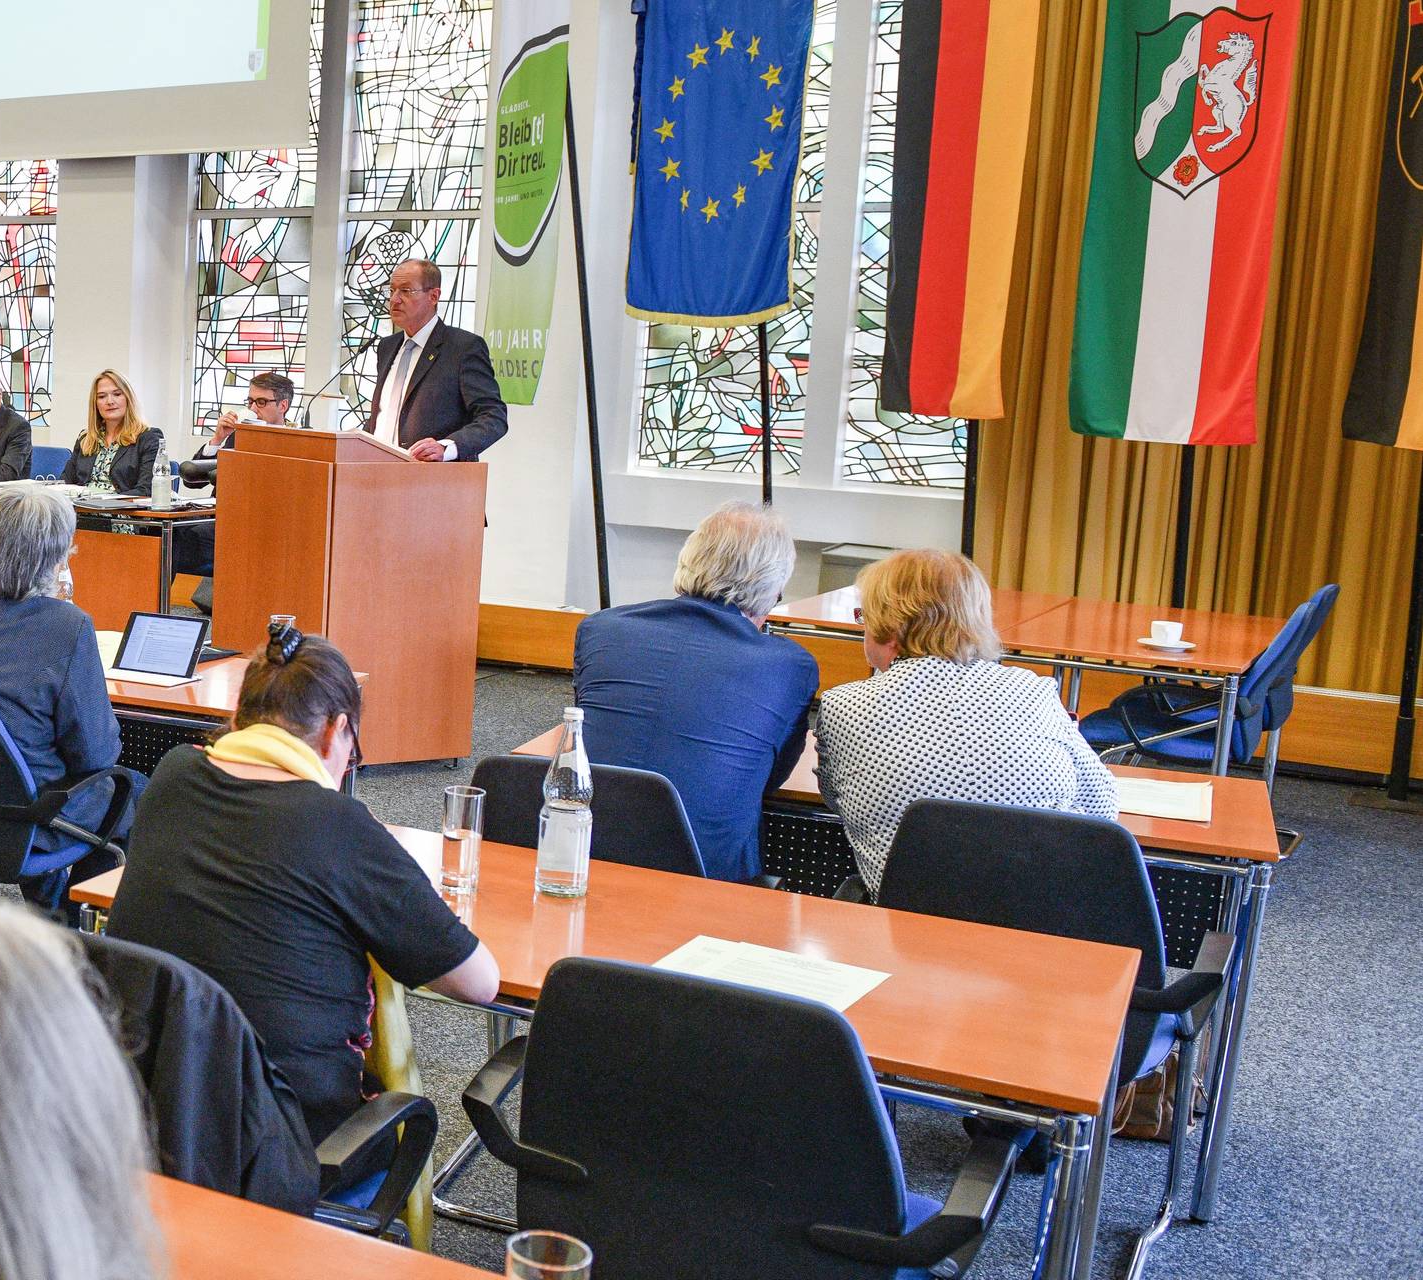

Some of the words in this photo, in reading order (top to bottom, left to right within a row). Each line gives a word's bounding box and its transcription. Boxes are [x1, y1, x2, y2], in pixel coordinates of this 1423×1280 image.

[499, 113, 545, 148] Bleib[t]
[497, 151, 518, 178] Dir
[520, 150, 546, 174] treu.
[491, 358, 543, 379] ADBEC
